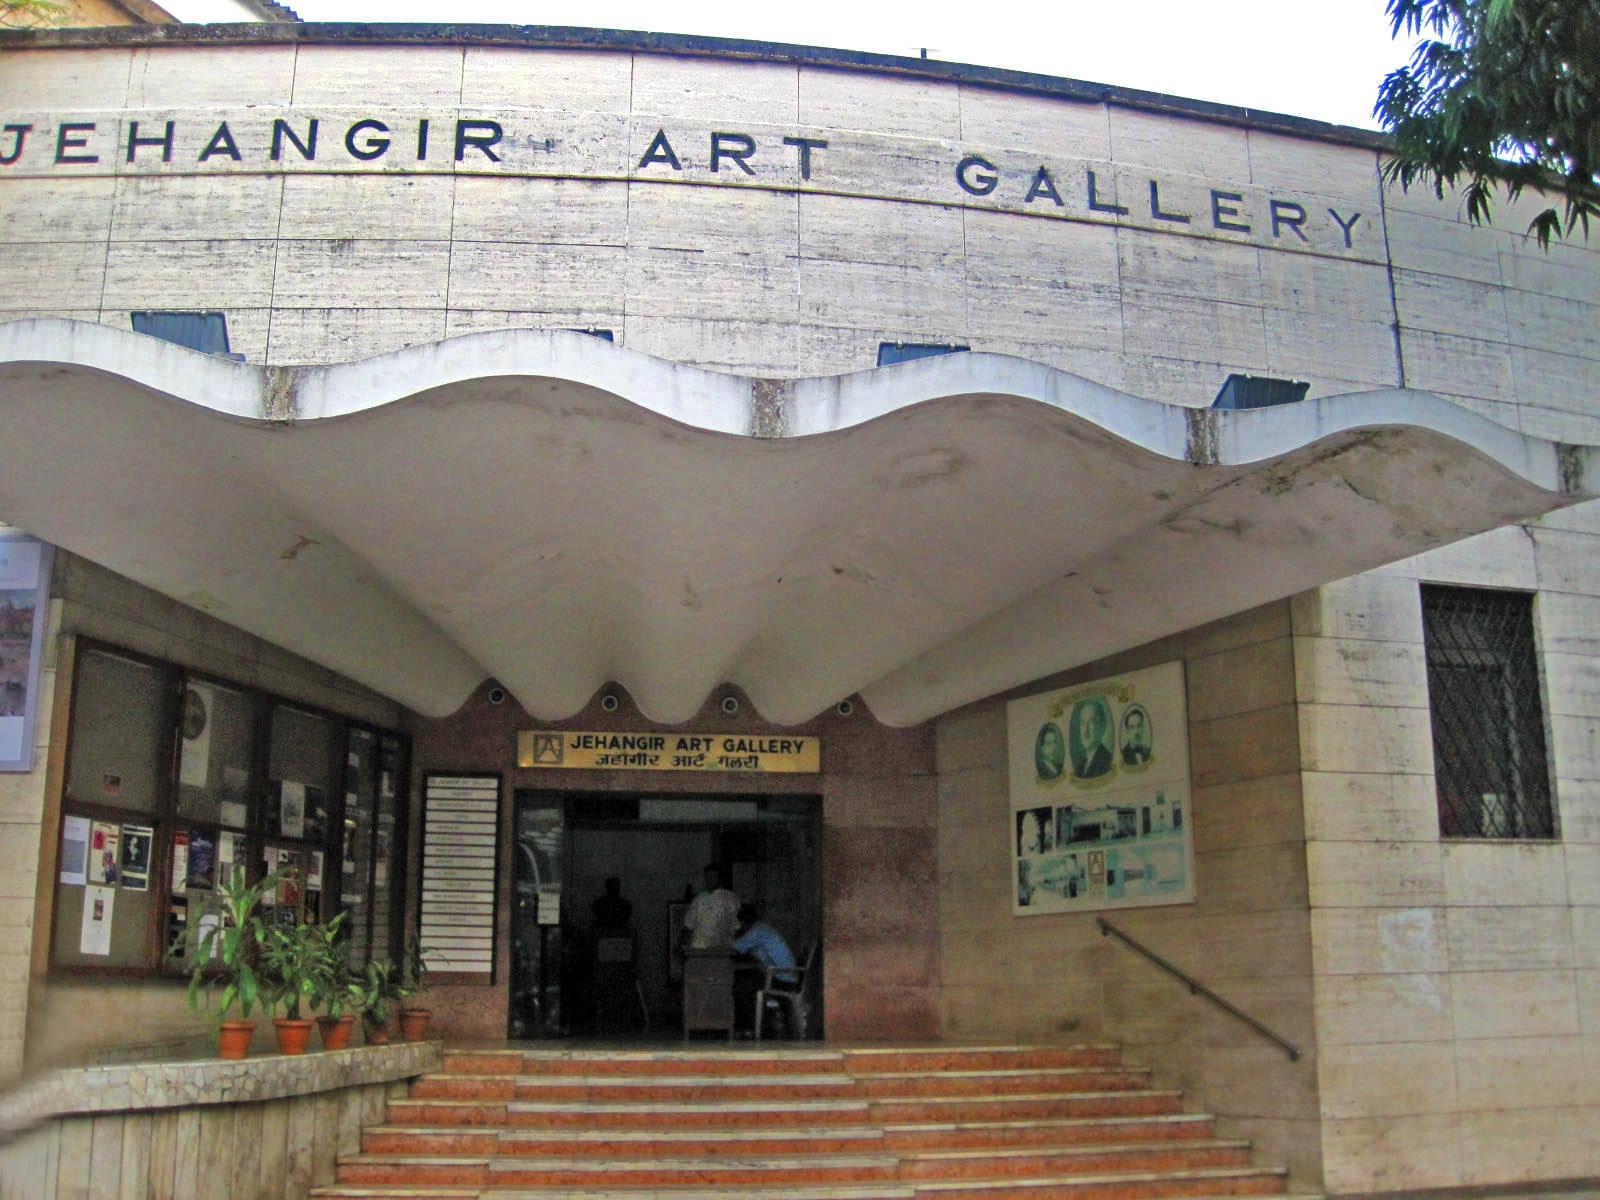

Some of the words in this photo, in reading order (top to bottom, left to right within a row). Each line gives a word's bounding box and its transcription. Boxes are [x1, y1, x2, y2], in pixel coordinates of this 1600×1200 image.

[0, 117, 503, 166] JEHANGIR
[638, 129, 829, 181] ART
[956, 156, 1362, 249] GALLERY
[570, 735, 665, 750] JEHANGIR
[676, 737, 714, 752] ART
[722, 738, 805, 754] GALLERY
[671, 753, 706, 767] आर्ट
